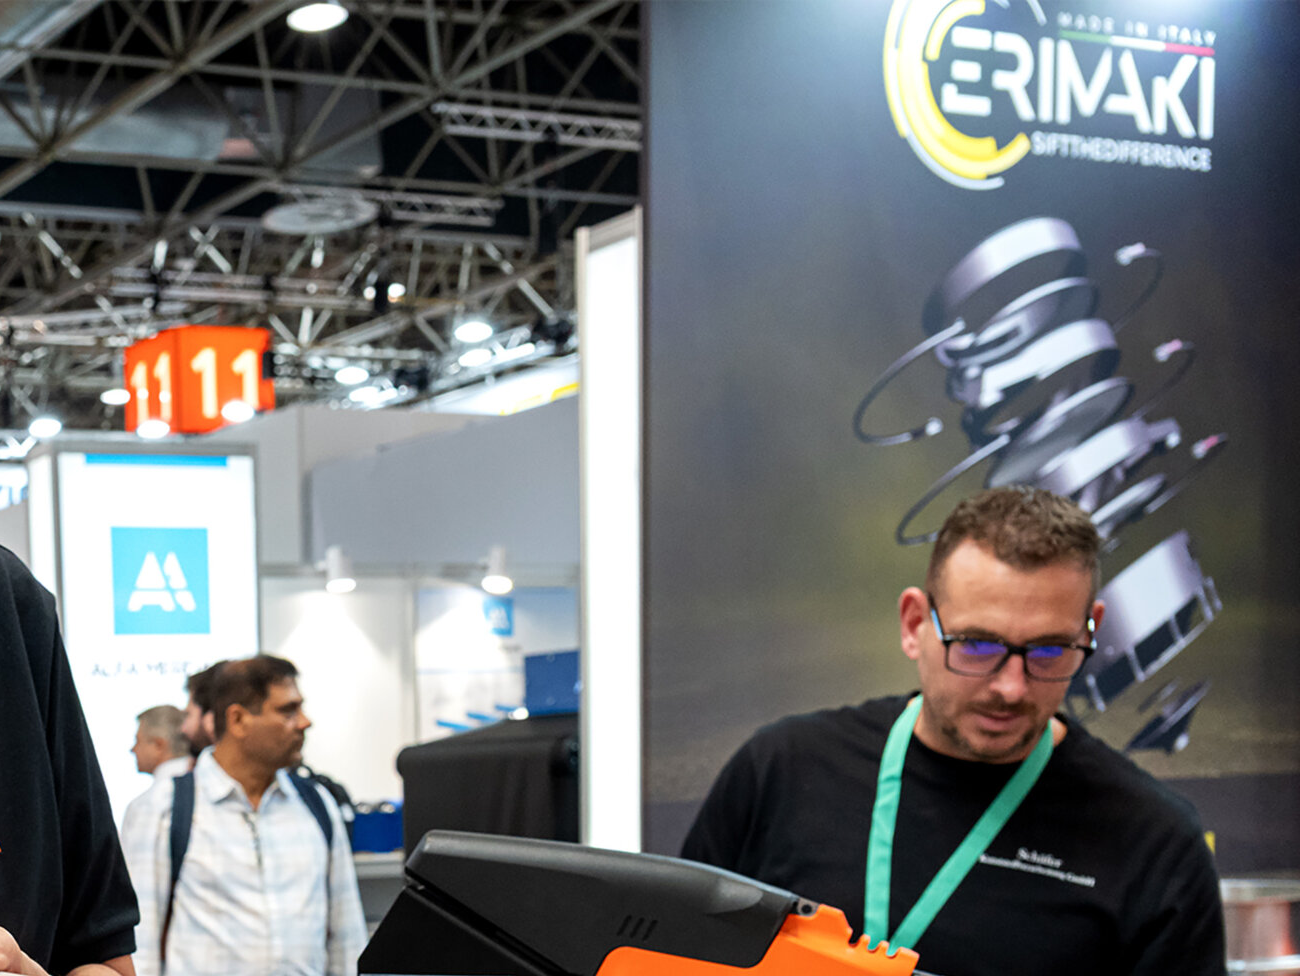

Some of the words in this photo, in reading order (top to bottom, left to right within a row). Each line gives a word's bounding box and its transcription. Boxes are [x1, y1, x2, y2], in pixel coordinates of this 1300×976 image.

[1057, 11, 1114, 34] MADE
[1125, 20, 1149, 38] IN
[1157, 24, 1216, 47] ITALY
[941, 25, 1216, 140] ERIMAKI
[130, 352, 172, 424] 11
[191, 347, 259, 419] 11
